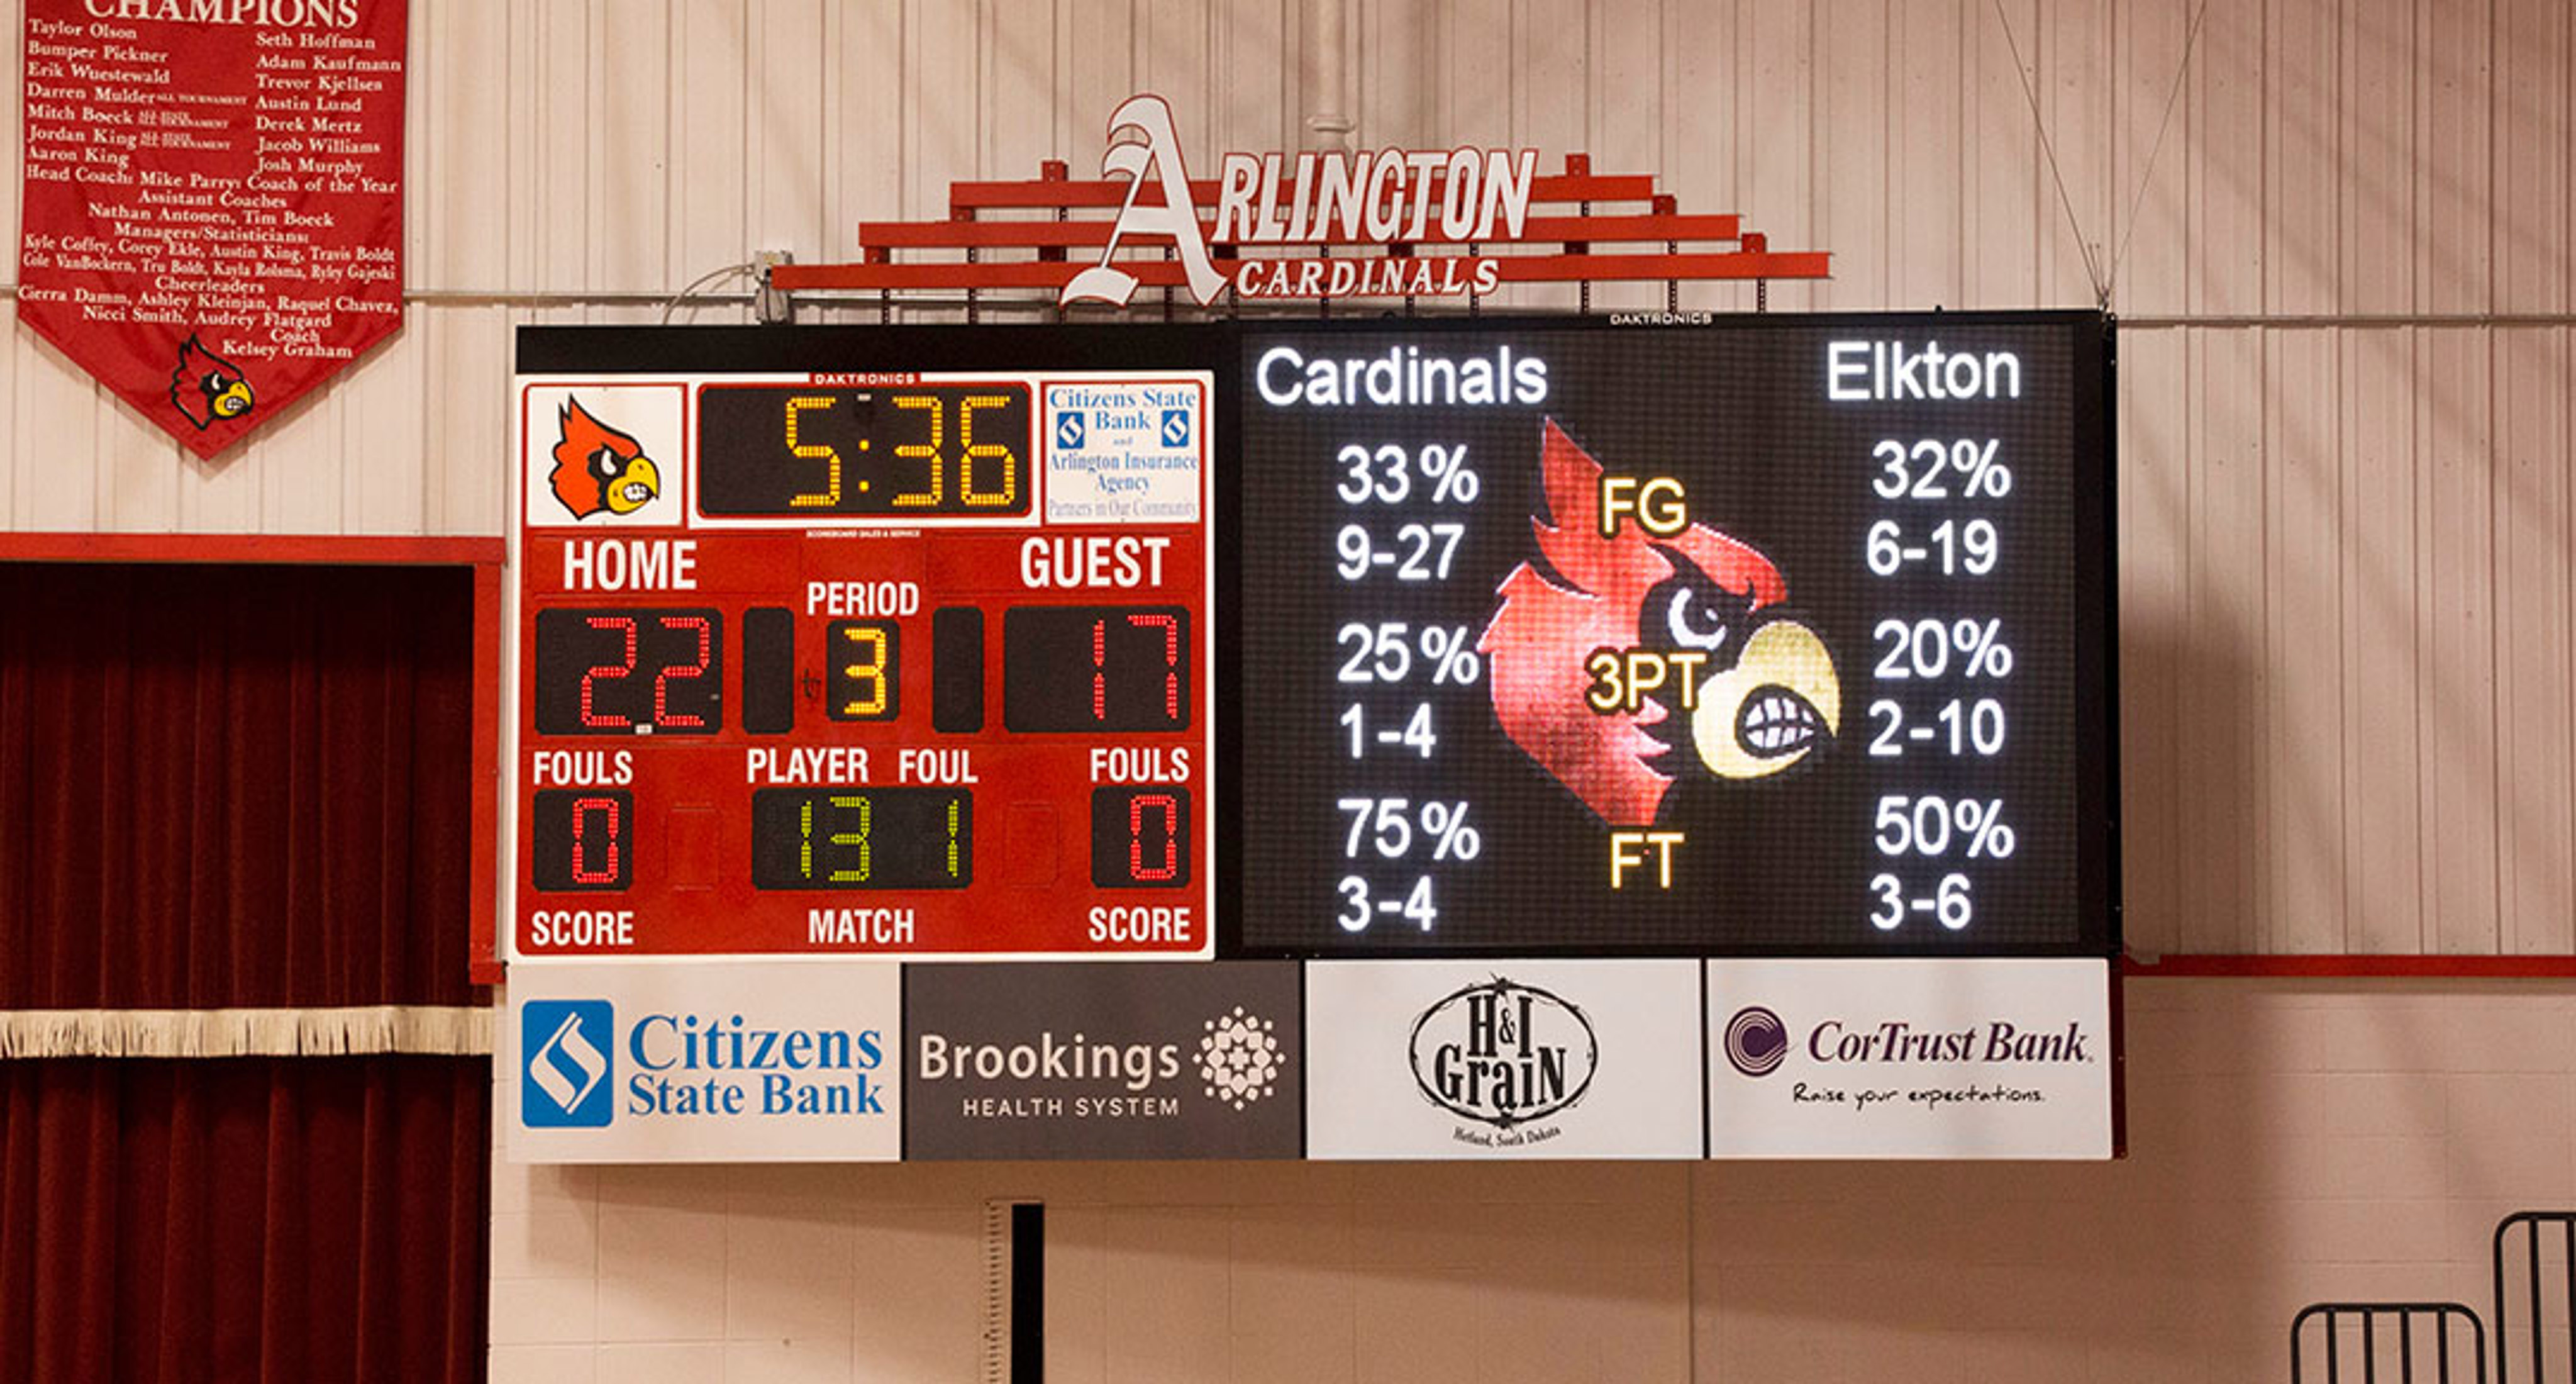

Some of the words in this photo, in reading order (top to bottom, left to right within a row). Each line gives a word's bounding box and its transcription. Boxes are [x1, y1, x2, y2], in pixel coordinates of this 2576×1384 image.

[28, 19, 82, 38] Taylor
[90, 23, 137, 39] Olson
[86, 0, 359, 28] CHAMPIONS
[28, 40, 96, 62] Bumper
[104, 45, 169, 63] Pickner
[256, 31, 292, 47] Seth
[300, 33, 376, 50] Hoffman
[28, 62, 64, 78] Erik
[256, 54, 306, 69] Adam
[313, 55, 402, 72] Kaufmann
[27, 82, 86, 99] Darren
[94, 86, 156, 104] Mulder
[255, 73, 311, 90] Trevor
[28, 103, 75, 121] Mitch
[82, 107, 134, 125] Boeck
[255, 95, 310, 111] Austin
[316, 96, 362, 112] Lund
[27, 125, 86, 143] Jordan
[94, 128, 137, 150] King
[256, 114, 306, 131] Derek
[313, 116, 362, 133] Mertz
[28, 146, 77, 161] Aaron
[84, 147, 130, 171] King
[253, 137, 303, 155] Jacob
[309, 138, 382, 153] Williams
[26, 164, 70, 181] Head
[140, 170, 182, 187] Mike
[247, 175, 299, 191] Coach
[304, 176, 325, 191] of
[329, 177, 356, 192] the
[361, 177, 399, 193] Year
[253, 157, 292, 175] Josh
[298, 157, 363, 177] Murphy
[88, 201, 152, 220] Nathan
[242, 209, 277, 225] Tim
[284, 210, 335, 227] Boeck
[138, 189, 214, 206] Assistant
[220, 190, 287, 208] Coaches
[1059, 94, 1539, 308] ARLINGTON
[23, 252, 50, 267] Cole
[140, 257, 167, 273] Tru
[213, 260, 250, 281] Kayla
[25, 233, 56, 253] Kyle
[118, 238, 164, 259] Corey
[209, 243, 258, 259] Austin
[262, 245, 306, 264] King,
[309, 245, 352, 261] Travis
[356, 246, 396, 262] Boldt
[155, 275, 265, 294] Cheerleaders
[1236, 257, 1500, 298] CARDINALS
[132, 306, 188, 325] Smith,
[194, 310, 257, 332] Audrey
[138, 291, 191, 313] Ashley
[277, 295, 330, 315] Raquel
[1609, 312, 1713, 325] DAKTRONICS
[223, 339, 279, 360] Kelsey
[283, 342, 353, 359] Graham
[269, 328, 320, 343] Coach
[814, 373, 915, 385] DAKTRONICS
[1257, 345, 1549, 406] Cardinals
[1827, 340, 2021, 401] Elkton
[1050, 388, 1136, 408] Citizens
[1142, 388, 1196, 408] State
[1096, 410, 1151, 430] Bank
[786, 395, 1014, 506] 5:36
[1050, 450, 1120, 473] Arlington
[1124, 450, 1198, 471] Insurance
[1872, 438, 2013, 499] 32%
[1096, 474, 1150, 495] Agency
[1602, 477, 1687, 533] FG
[564, 539, 697, 591] HOME
[1020, 537, 1170, 588] GUEST
[1336, 523, 1466, 581] 9-27
[1867, 518, 1998, 576] 6-19
[807, 581, 919, 617] PERIOD
[1872, 618, 2014, 679] 20%
[580, 617, 710, 726] 22
[844, 627, 886, 714] 3
[1093, 614, 1177, 720] 17
[1589, 652, 1707, 709] 3PT
[1339, 702, 1437, 759] 1-4
[1868, 698, 2006, 756] 2-10
[533, 750, 634, 786] FOULS
[747, 747, 869, 784] PLAYER
[898, 749, 979, 784] FOUL
[1089, 747, 1190, 783] FOULS
[572, 798, 619, 884] 0
[801, 796, 870, 882] 13
[948, 799, 958, 878] 1
[1130, 794, 1177, 880] 0
[1874, 795, 2015, 858] 50%
[1610, 832, 1685, 890] FT
[1337, 875, 1438, 932] 3-4
[1868, 873, 1972, 930] 3-6
[531, 910, 634, 946] SCORE
[808, 908, 915, 944] MATCH
[1088, 906, 1191, 943] SCORE
[629, 1013, 883, 1071] Citizens
[1467, 993, 1533, 1058] H&I
[1808, 1020, 1977, 1063] CorTrust
[919, 1032, 1180, 1091] Brookings
[628, 1073, 746, 1117] State
[760, 1072, 886, 1117] Bank
[962, 1098, 1063, 1117] HEALTH
[1075, 1097, 1180, 1117] SYSTEM
[1792, 1081, 1845, 1103] Raise
[1854, 1086, 1899, 1111] your
[1907, 1084, 2046, 1110] expectations.
